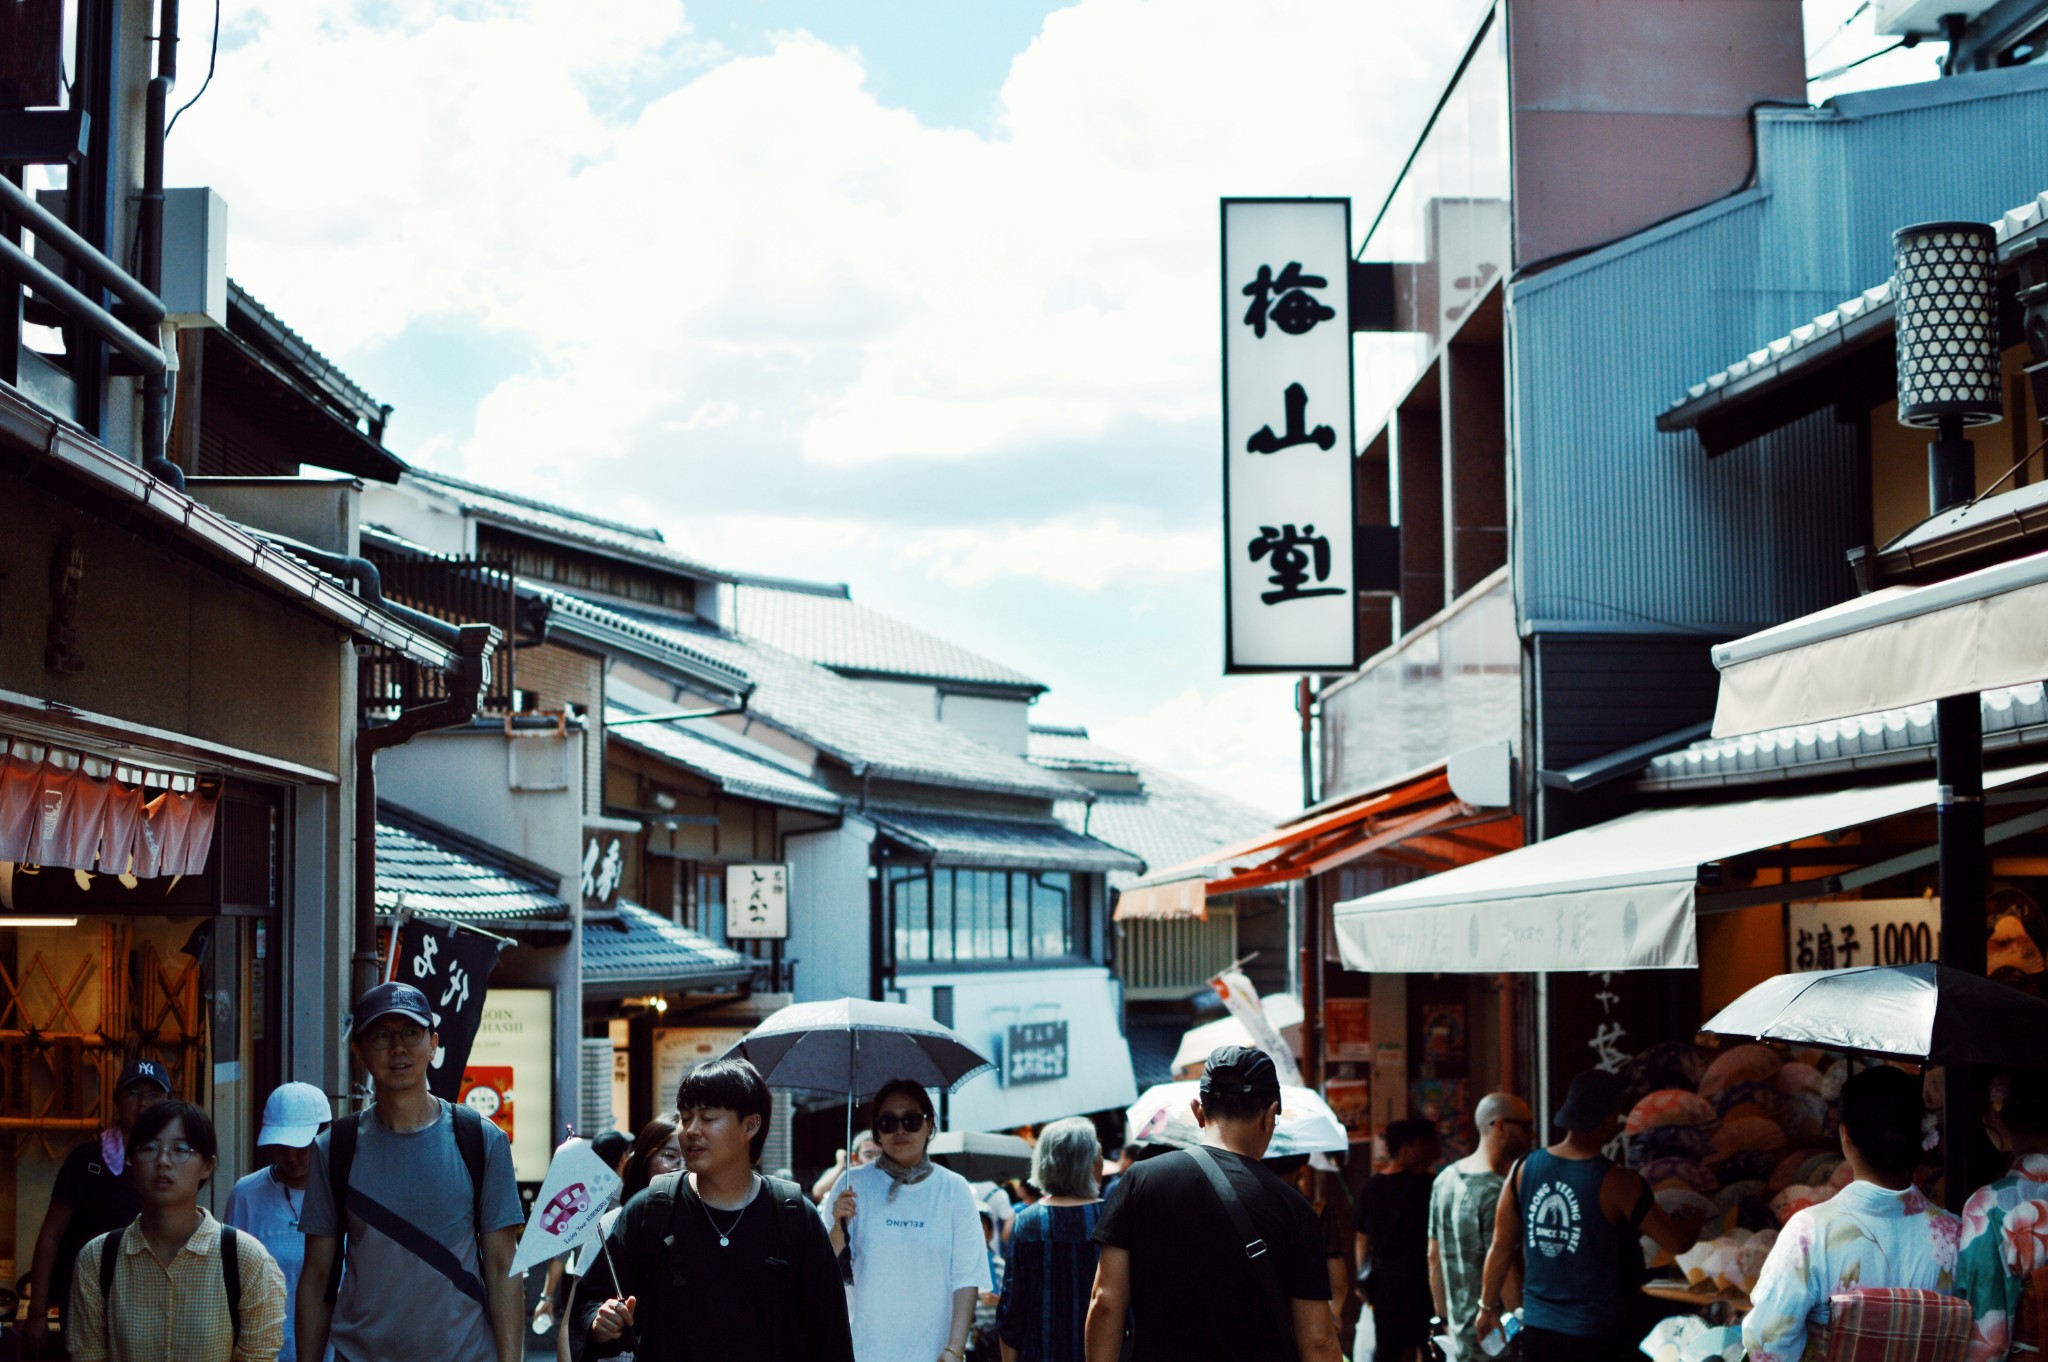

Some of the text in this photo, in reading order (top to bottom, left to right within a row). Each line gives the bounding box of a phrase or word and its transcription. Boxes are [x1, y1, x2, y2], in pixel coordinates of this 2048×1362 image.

[1242, 261, 1347, 604] 梅山堂
[749, 870, 767, 923] とんかつ
[1797, 921, 1941, 970] お扇子 1000
[563, 1231, 578, 1244] Enjoy
[576, 1221, 588, 1232] Your
[1528, 1181, 1582, 1254] BILLABONG FEELING FREE
[1536, 1227, 1557, 1239] SINCE
